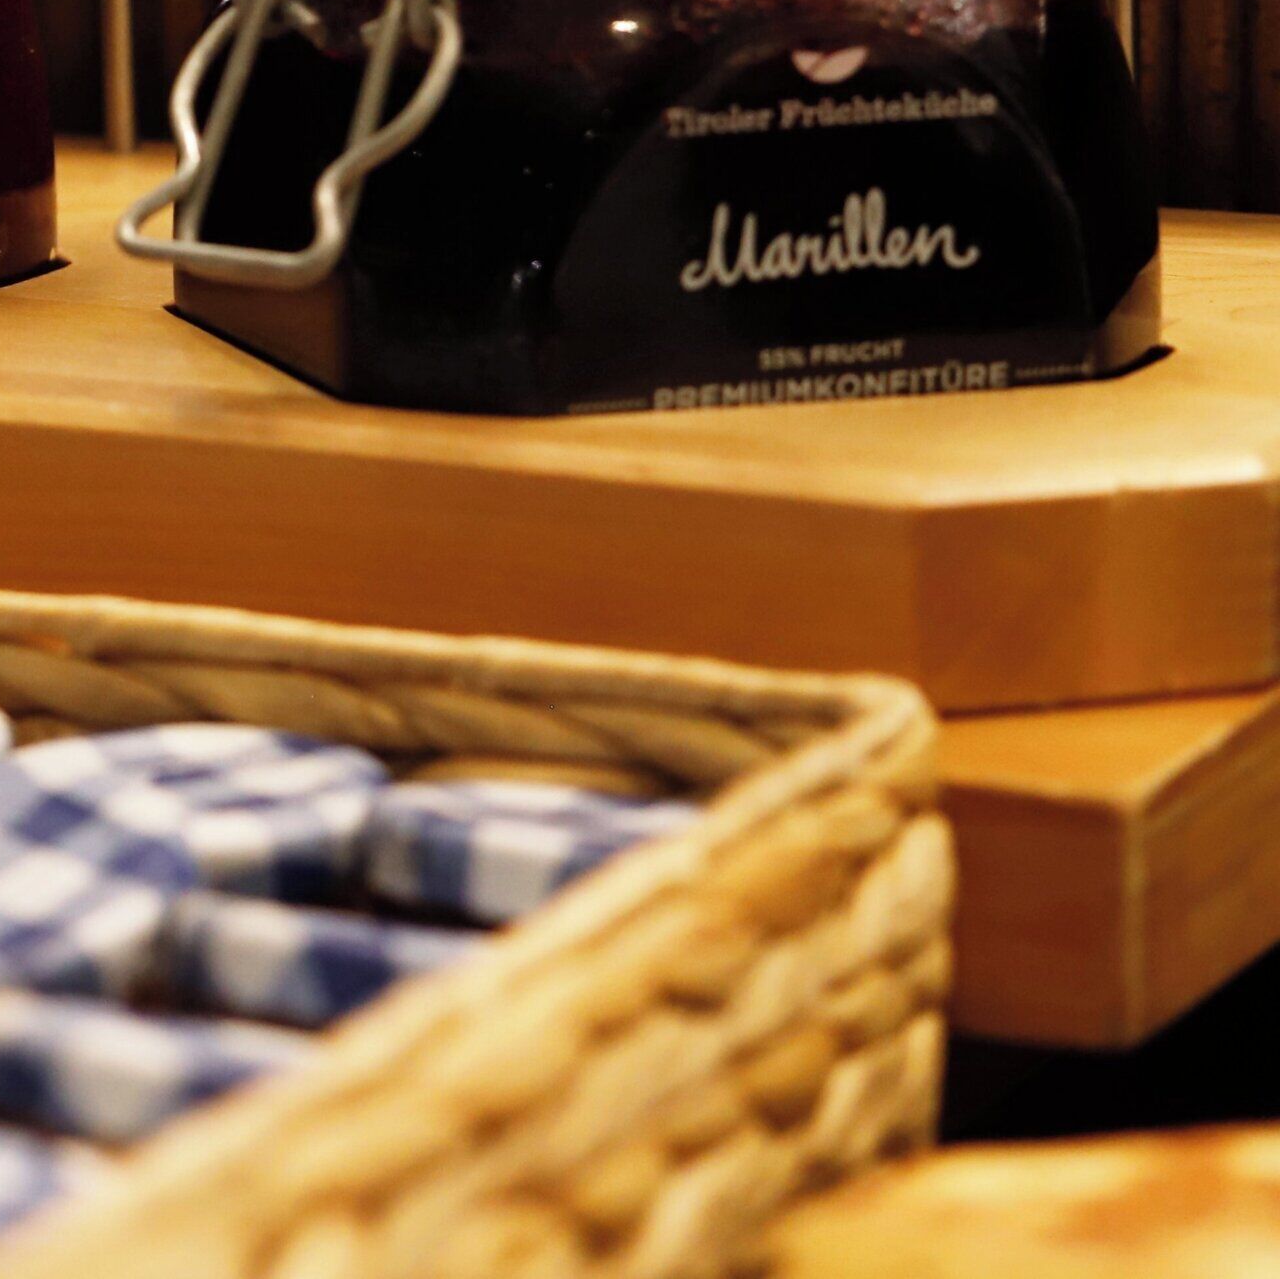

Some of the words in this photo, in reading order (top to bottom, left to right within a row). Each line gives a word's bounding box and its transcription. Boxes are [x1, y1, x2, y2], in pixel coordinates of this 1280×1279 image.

[665, 103, 773, 139] Tiroler
[680, 185, 981, 292] Marillen
[809, 338, 906, 366] FRUCHT
